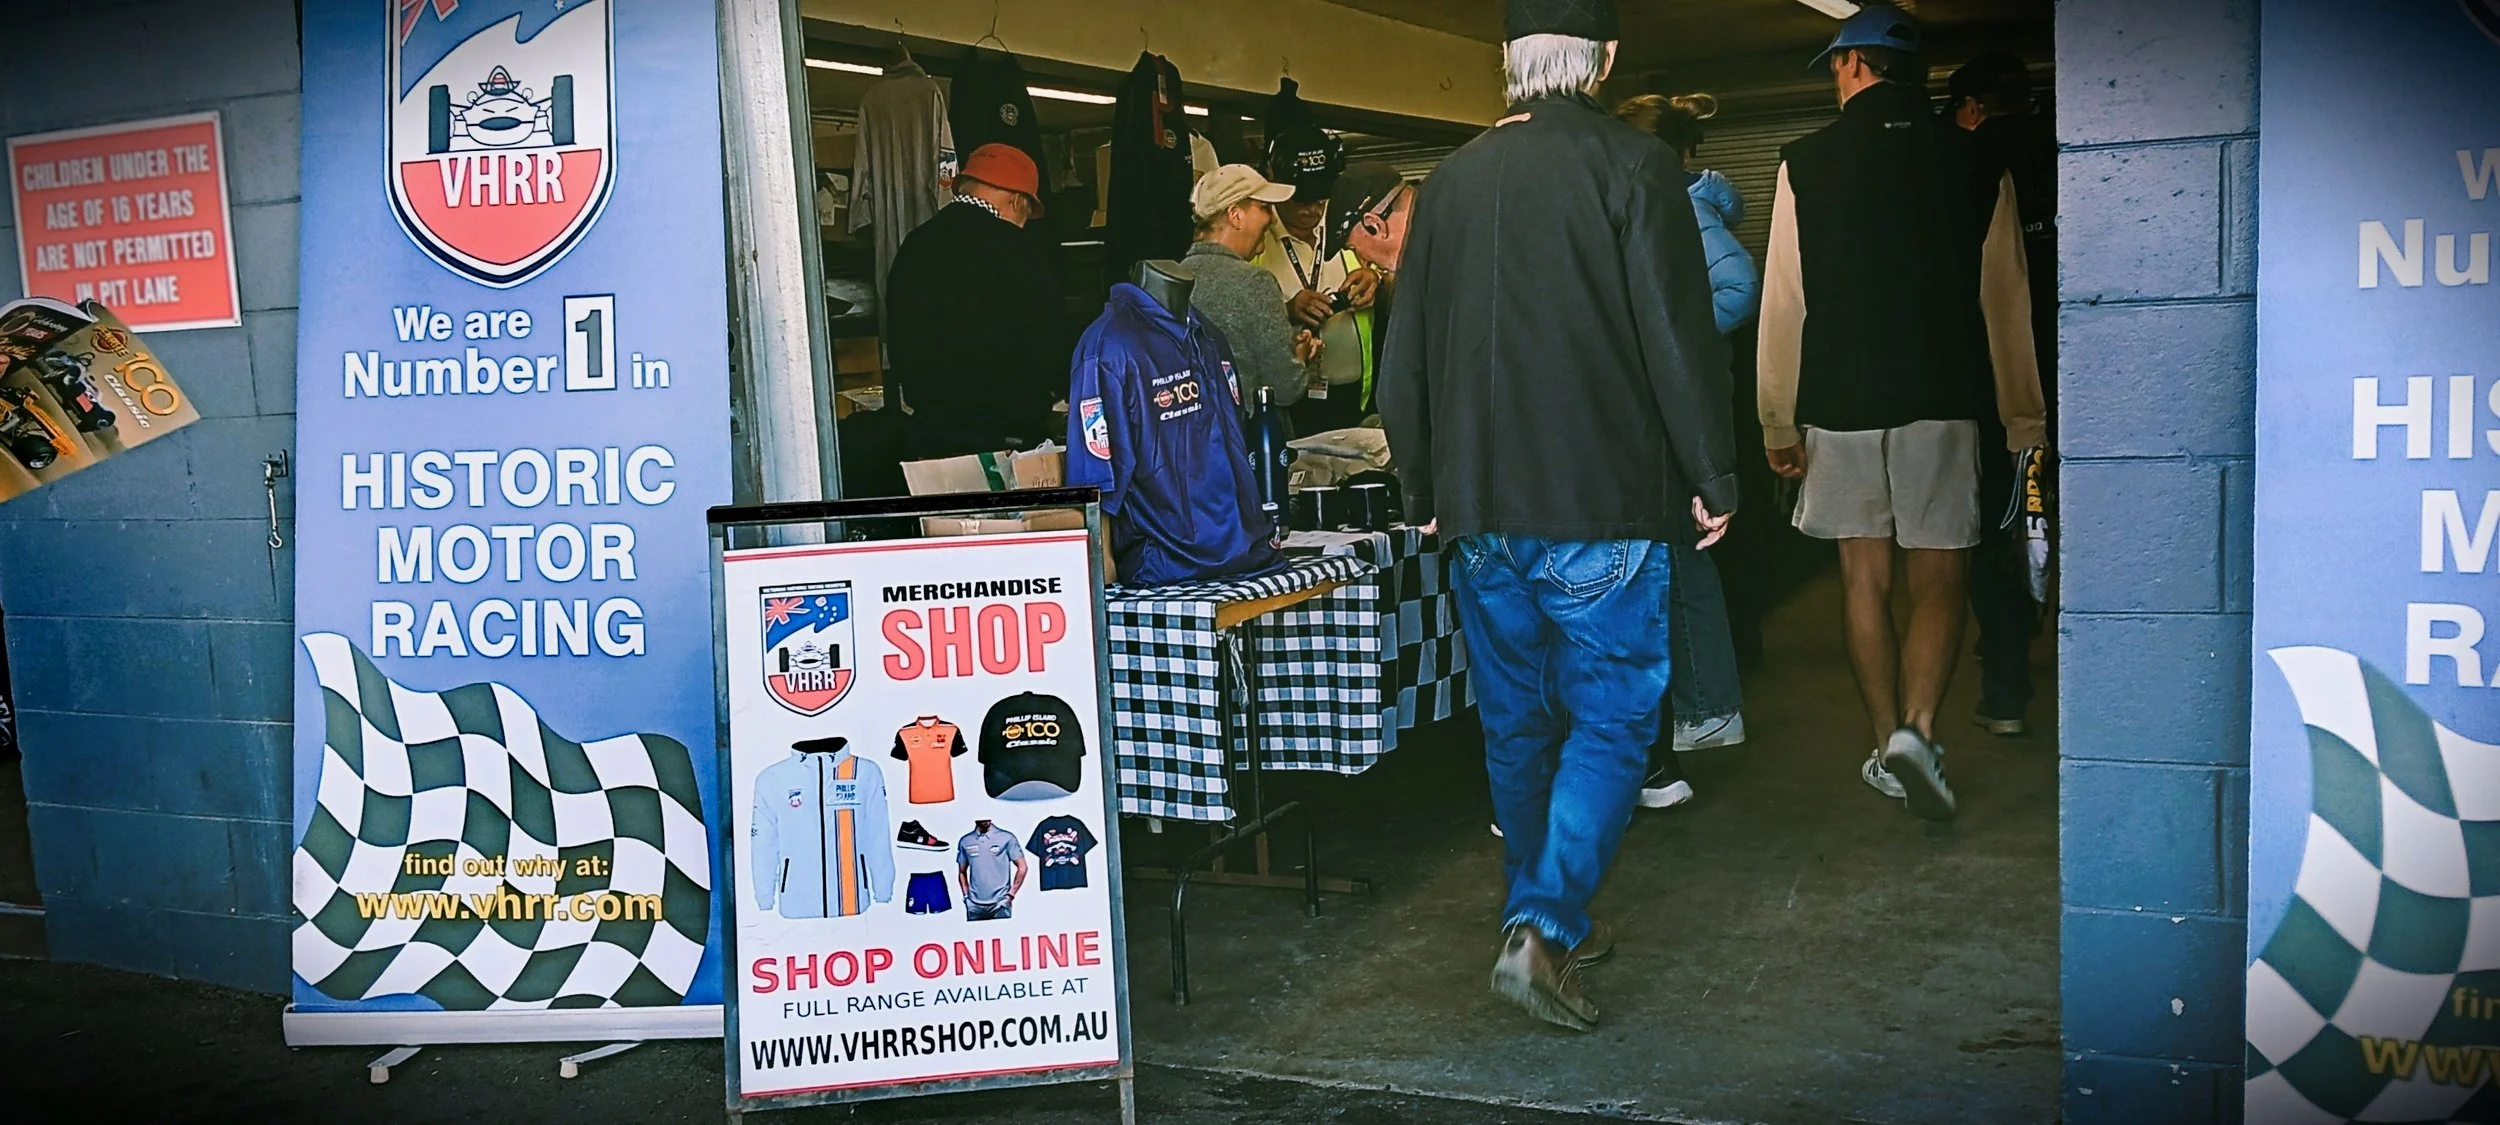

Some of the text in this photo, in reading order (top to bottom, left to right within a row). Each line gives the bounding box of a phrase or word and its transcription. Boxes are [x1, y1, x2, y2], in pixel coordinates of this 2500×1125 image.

[23, 144, 210, 191] CHILDREN UNDER THE
[437, 152, 565, 207] VHRR
[46, 189, 194, 230] AGE OF 16 YEARS
[36, 230, 216, 272] ARE NOT PERMITTED
[76, 276, 180, 307] IN PIT LANE
[393, 305, 532, 341] We are
[113, 351, 180, 416] 100
[343, 347, 558, 398] Number
[631, 352, 671, 389] in
[104, 374, 151, 428] Classic
[1160, 402, 1202, 420] Classi
[341, 445, 676, 510] HISTORIC
[377, 523, 637, 584] MOTOR
[882, 577, 1062, 603] MERCHANDISE
[371, 598, 646, 658] RACING
[881, 601, 1066, 681] SHOP
[783, 671, 838, 694] VHRR
[1025, 722, 1060, 737] 100
[404, 853, 609, 881] find out why at:
[356, 886, 664, 921] www.vhrr.com
[751, 931, 1102, 994] SHOP ONLINE
[783, 977, 1089, 1019] FULL RANGE AVAILABLE AT
[751, 1011, 1108, 1070] WWW.VHRRSHOP.COM.AU
